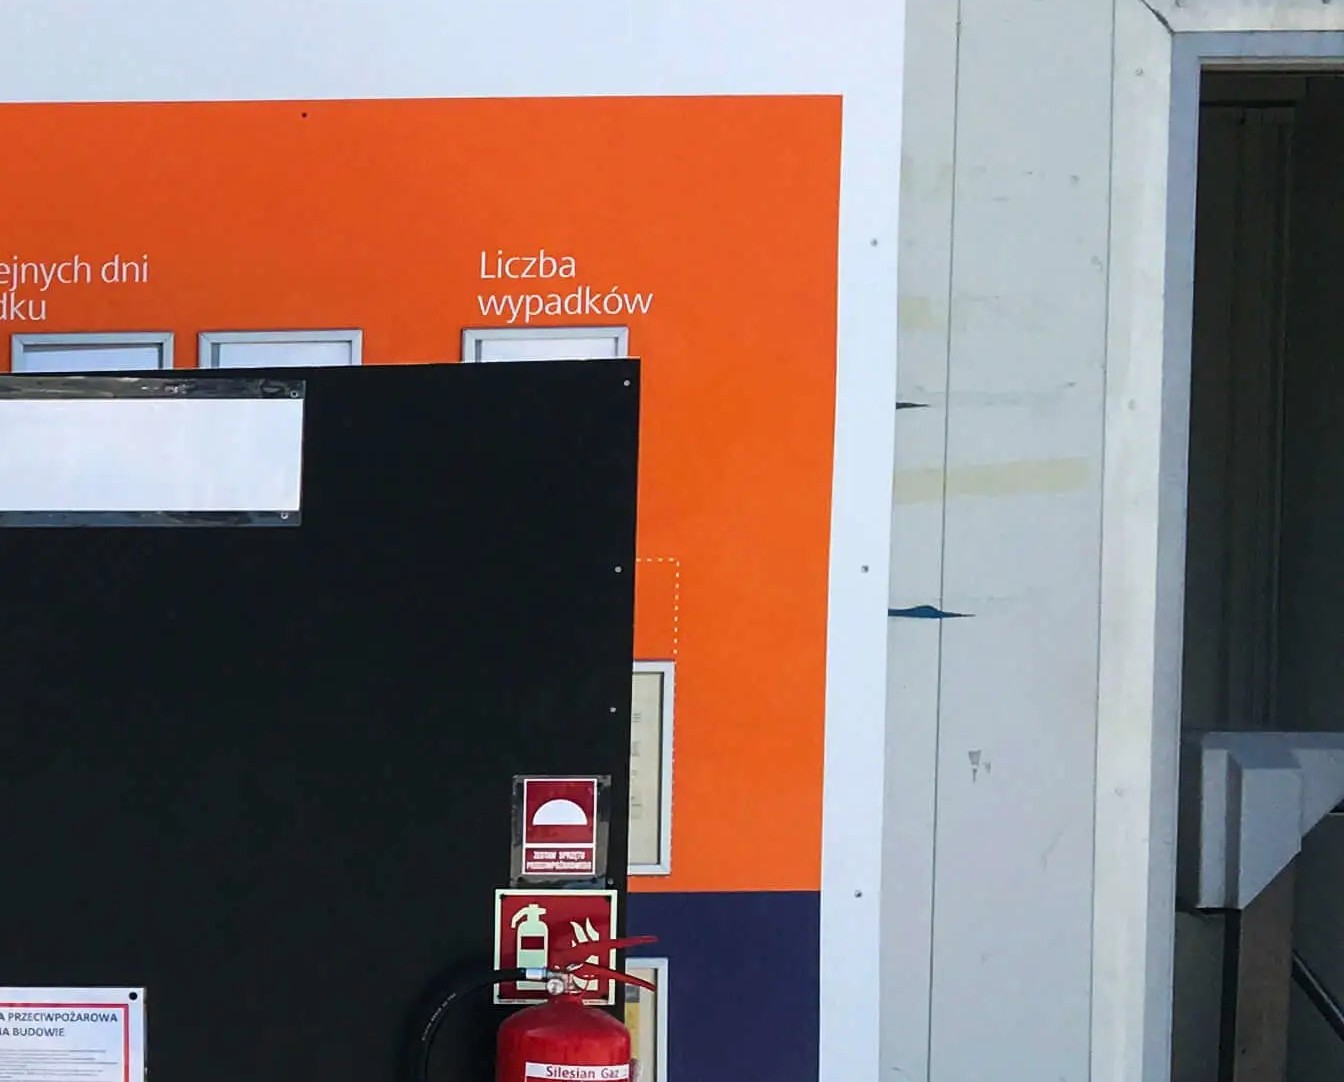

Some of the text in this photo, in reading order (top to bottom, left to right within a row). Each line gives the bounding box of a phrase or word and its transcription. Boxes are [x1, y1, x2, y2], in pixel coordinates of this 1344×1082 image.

[101, 254, 149, 283] dni
[480, 249, 576, 279] Liczba
[477, 286, 654, 323] wypadków
[8, 1010, 118, 1022] PRZECIWPOŻAROWA
[12, 1027, 65, 1037] BUDOWIE
[546, 1066, 595, 1079] Silesian
